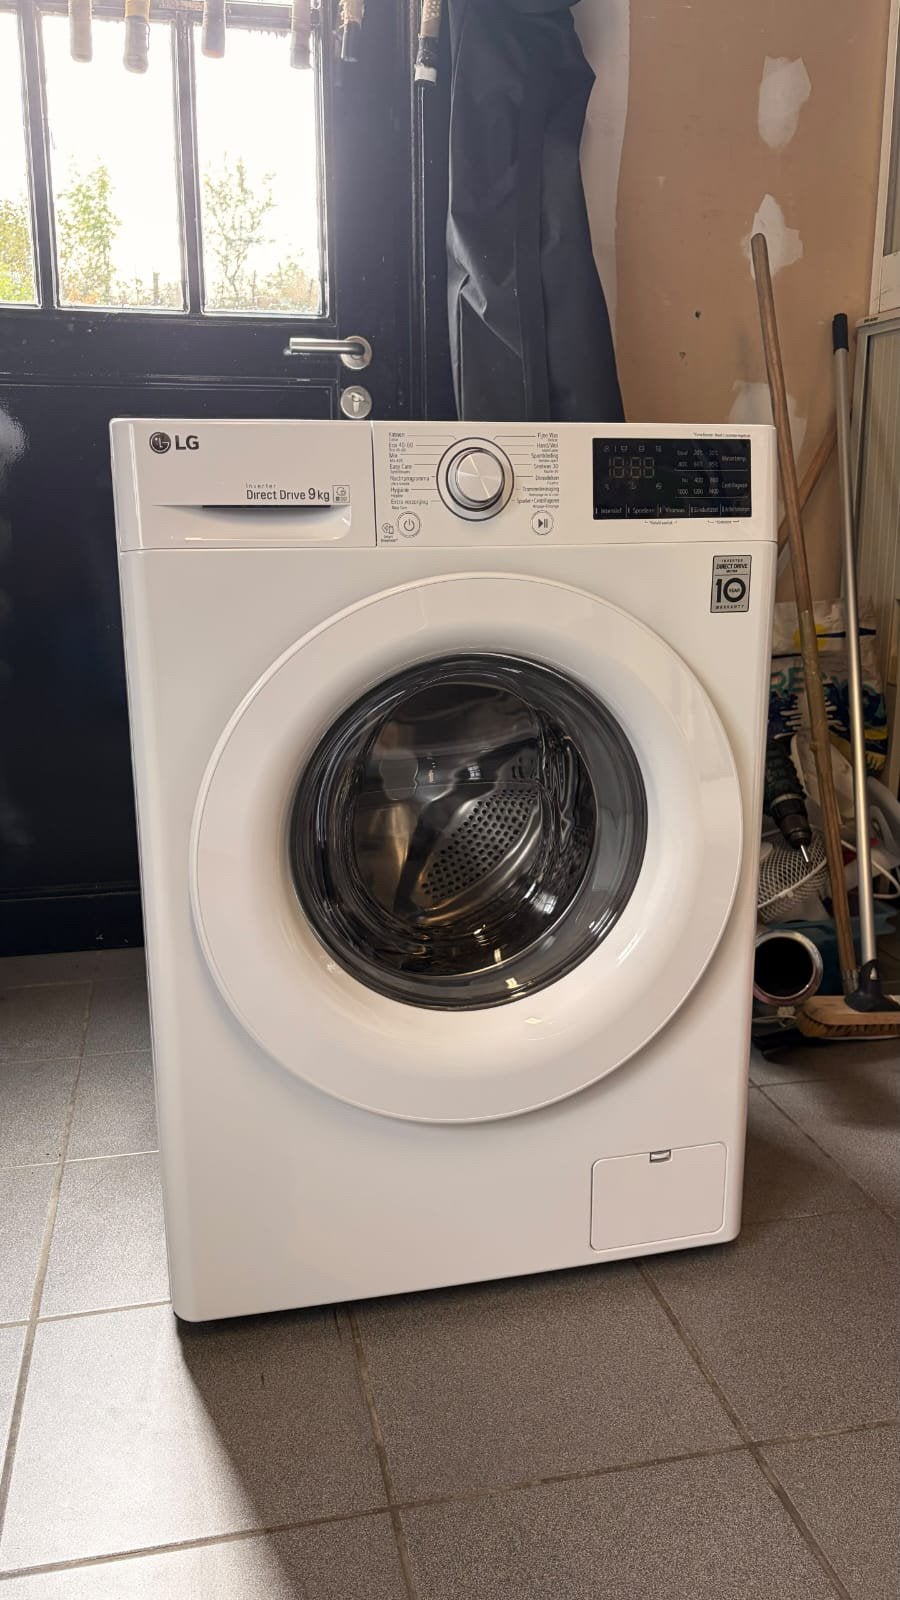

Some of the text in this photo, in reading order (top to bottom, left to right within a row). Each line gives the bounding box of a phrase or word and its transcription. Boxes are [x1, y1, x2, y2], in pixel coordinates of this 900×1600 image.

[175, 435, 199, 450] LG
[246, 490, 277, 500] Direct
[280, 490, 306, 500] Drive
[308, 488, 316, 500] 9
[317, 490, 330, 502] kg
[716, 578, 746, 602] 10
